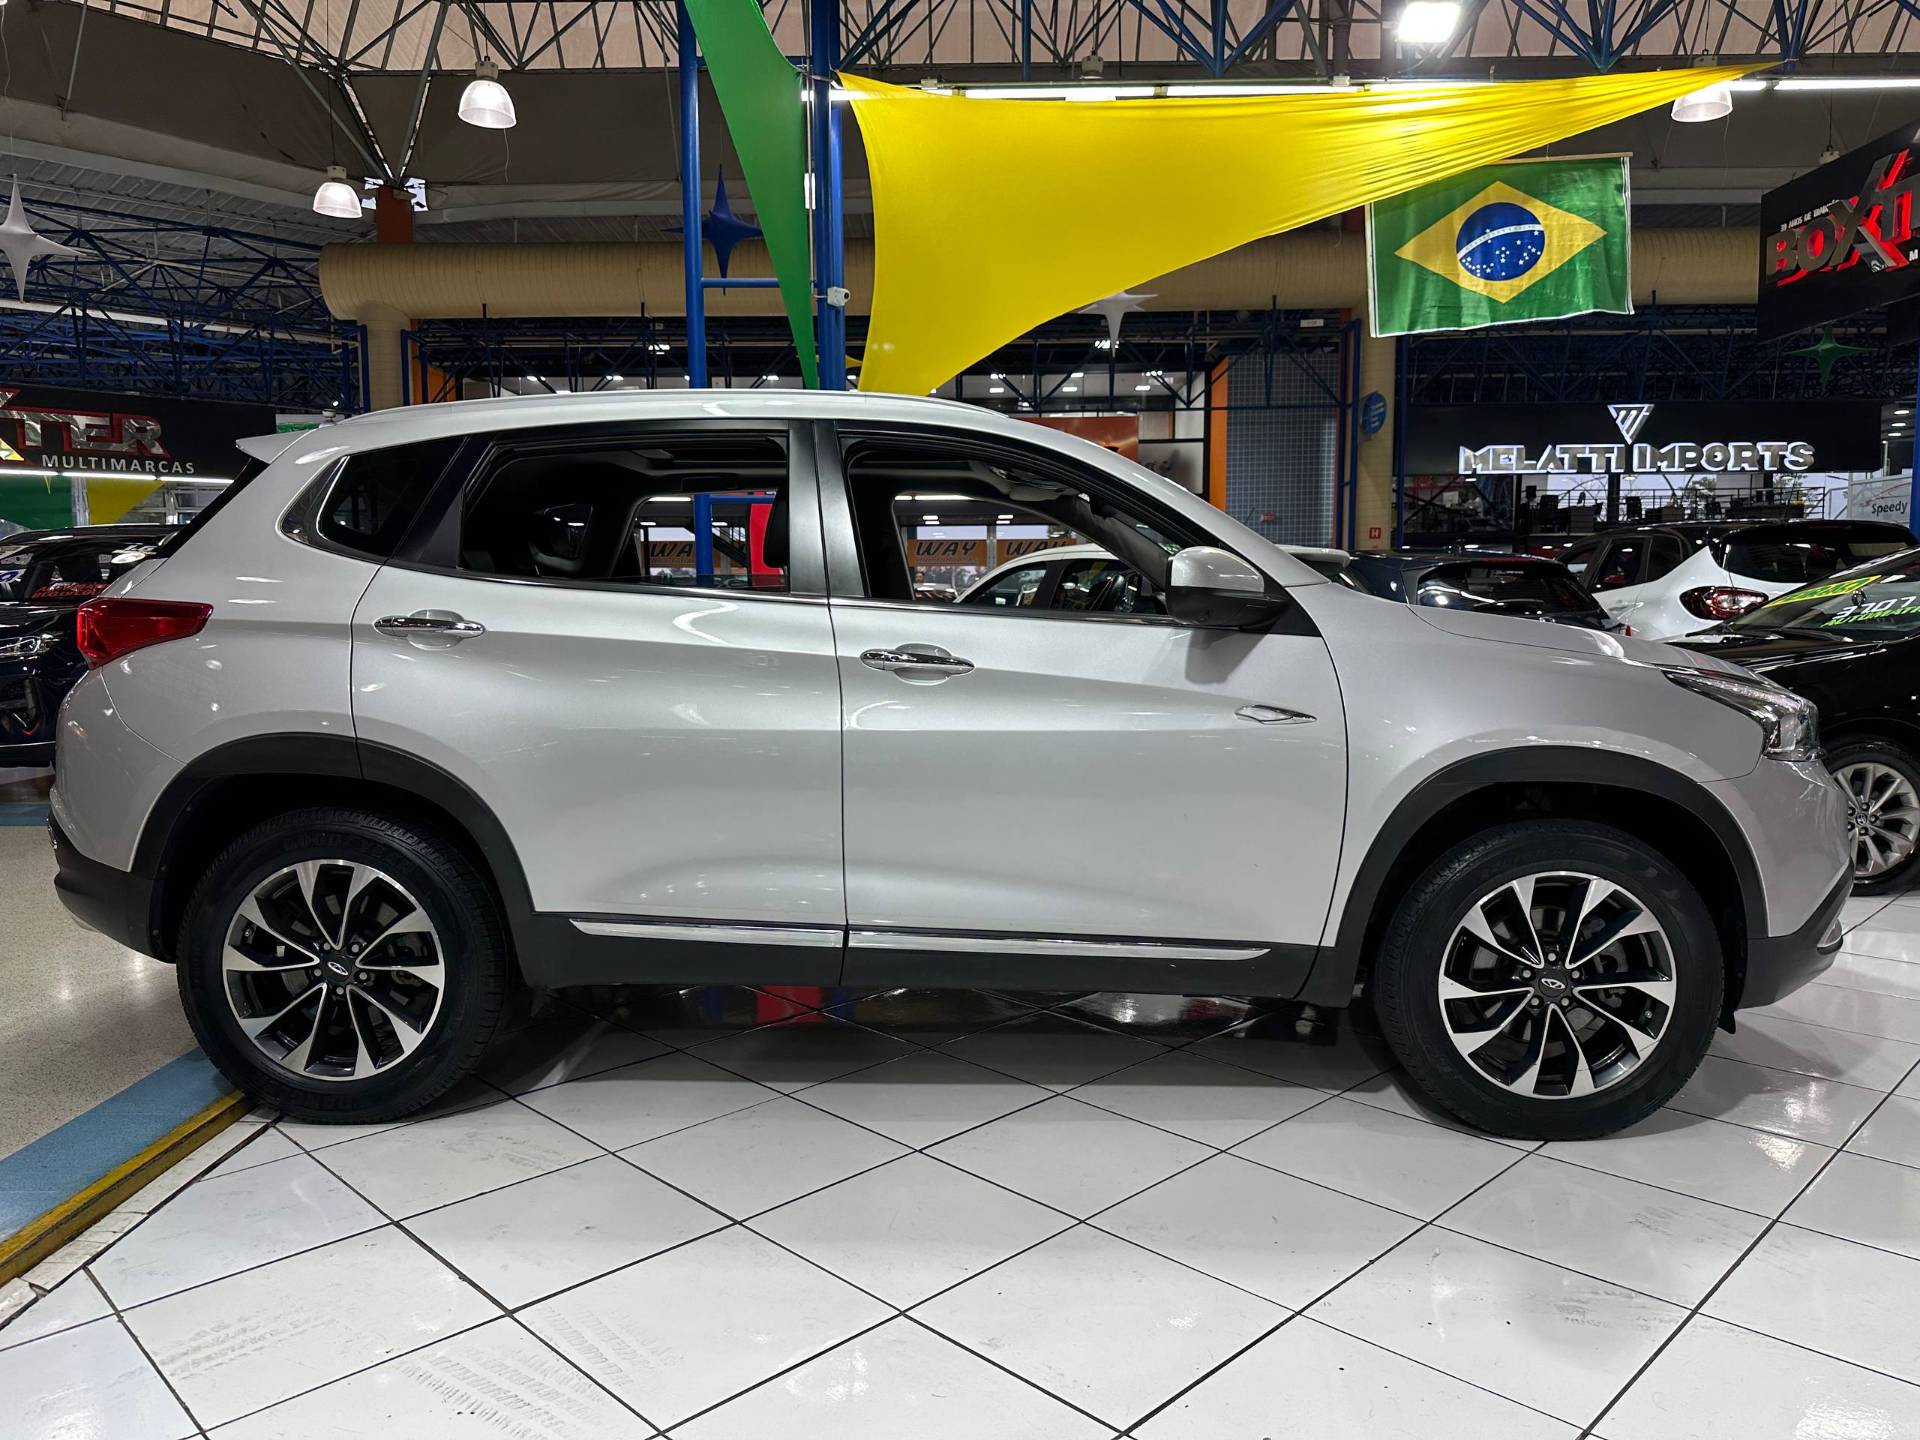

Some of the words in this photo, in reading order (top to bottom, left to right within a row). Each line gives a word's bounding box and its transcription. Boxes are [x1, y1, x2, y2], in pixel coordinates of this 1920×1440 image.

[41, 454, 196, 475] MULTIMARCAS
[1458, 444, 1626, 475] MELATTI
[1632, 441, 1816, 472] IMPORTS
[1871, 500, 1909, 517] Speedy
[916, 541, 977, 556] WAY
[1820, 605, 1920, 628] AUTOMATI
